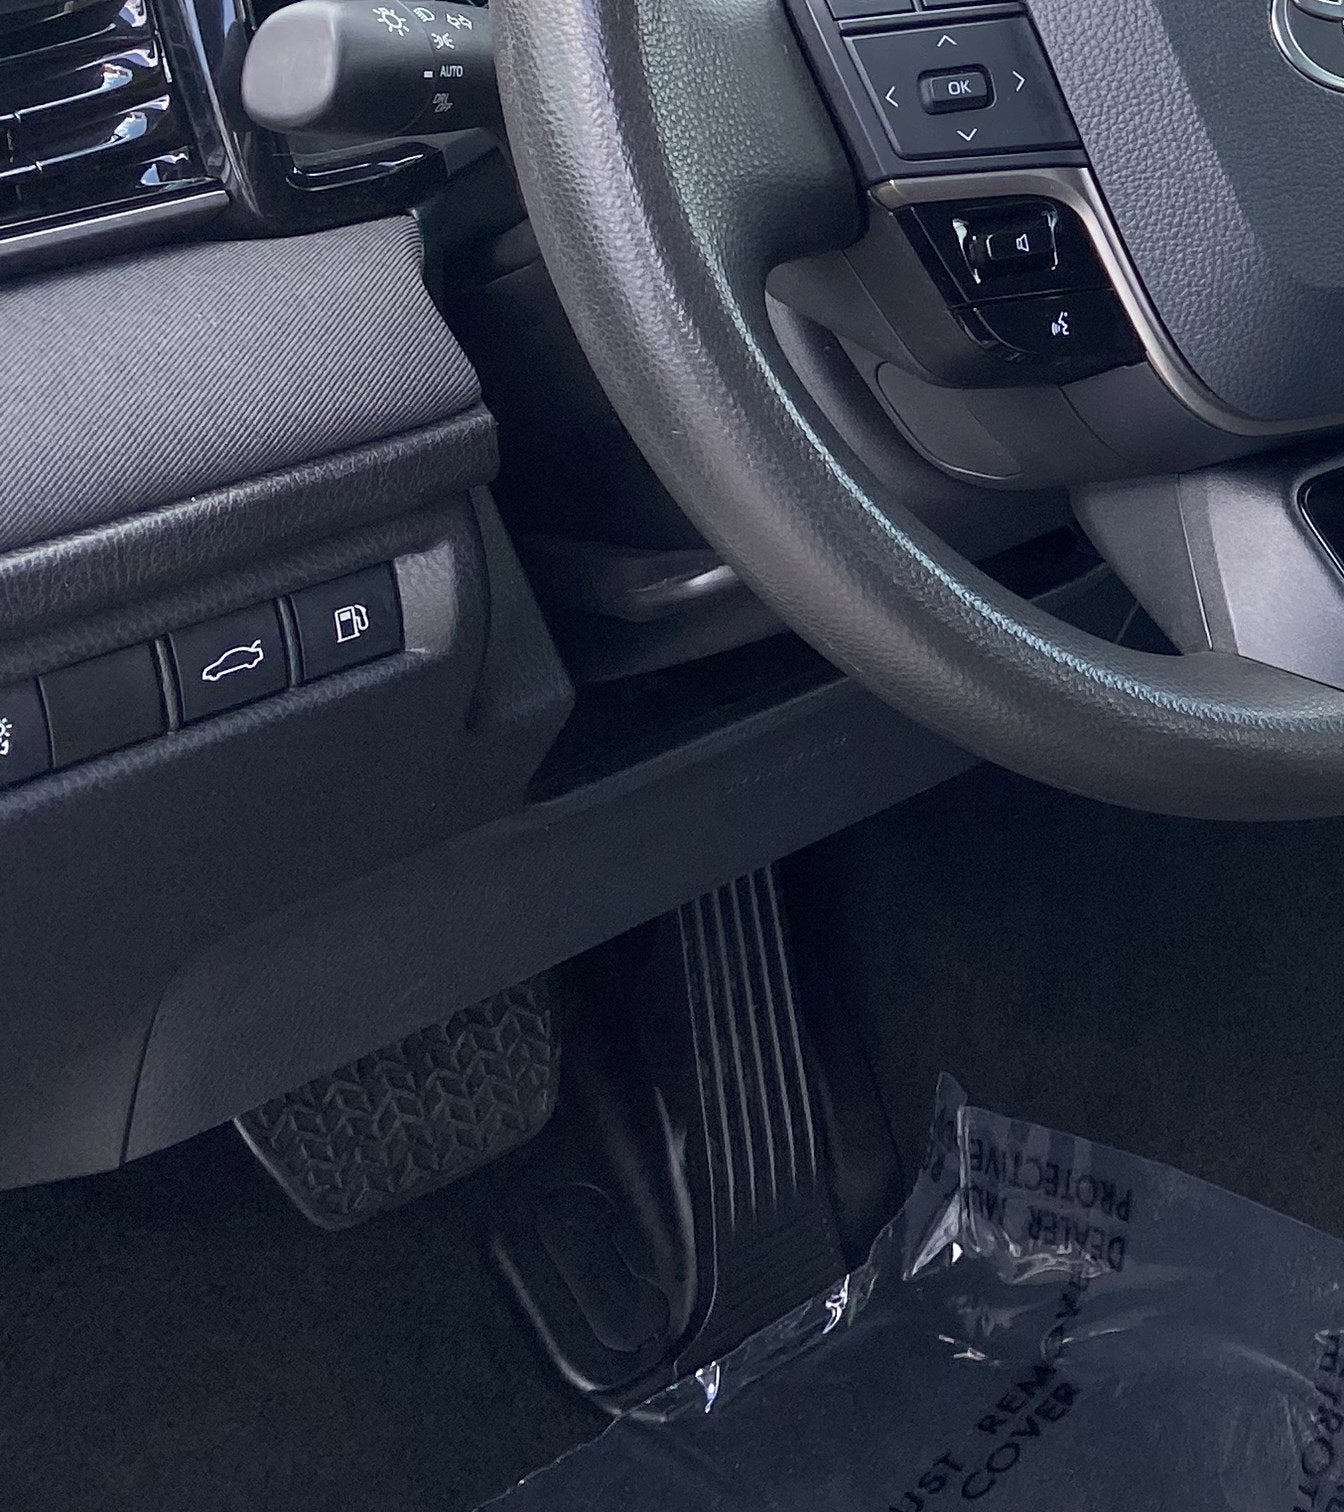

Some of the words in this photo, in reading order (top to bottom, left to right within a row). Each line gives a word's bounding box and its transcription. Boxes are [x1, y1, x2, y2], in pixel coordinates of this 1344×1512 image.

[440, 64, 464, 78] AUTO
[947, 80, 973, 96] OK
[961, 1381, 1081, 1501] COVER
